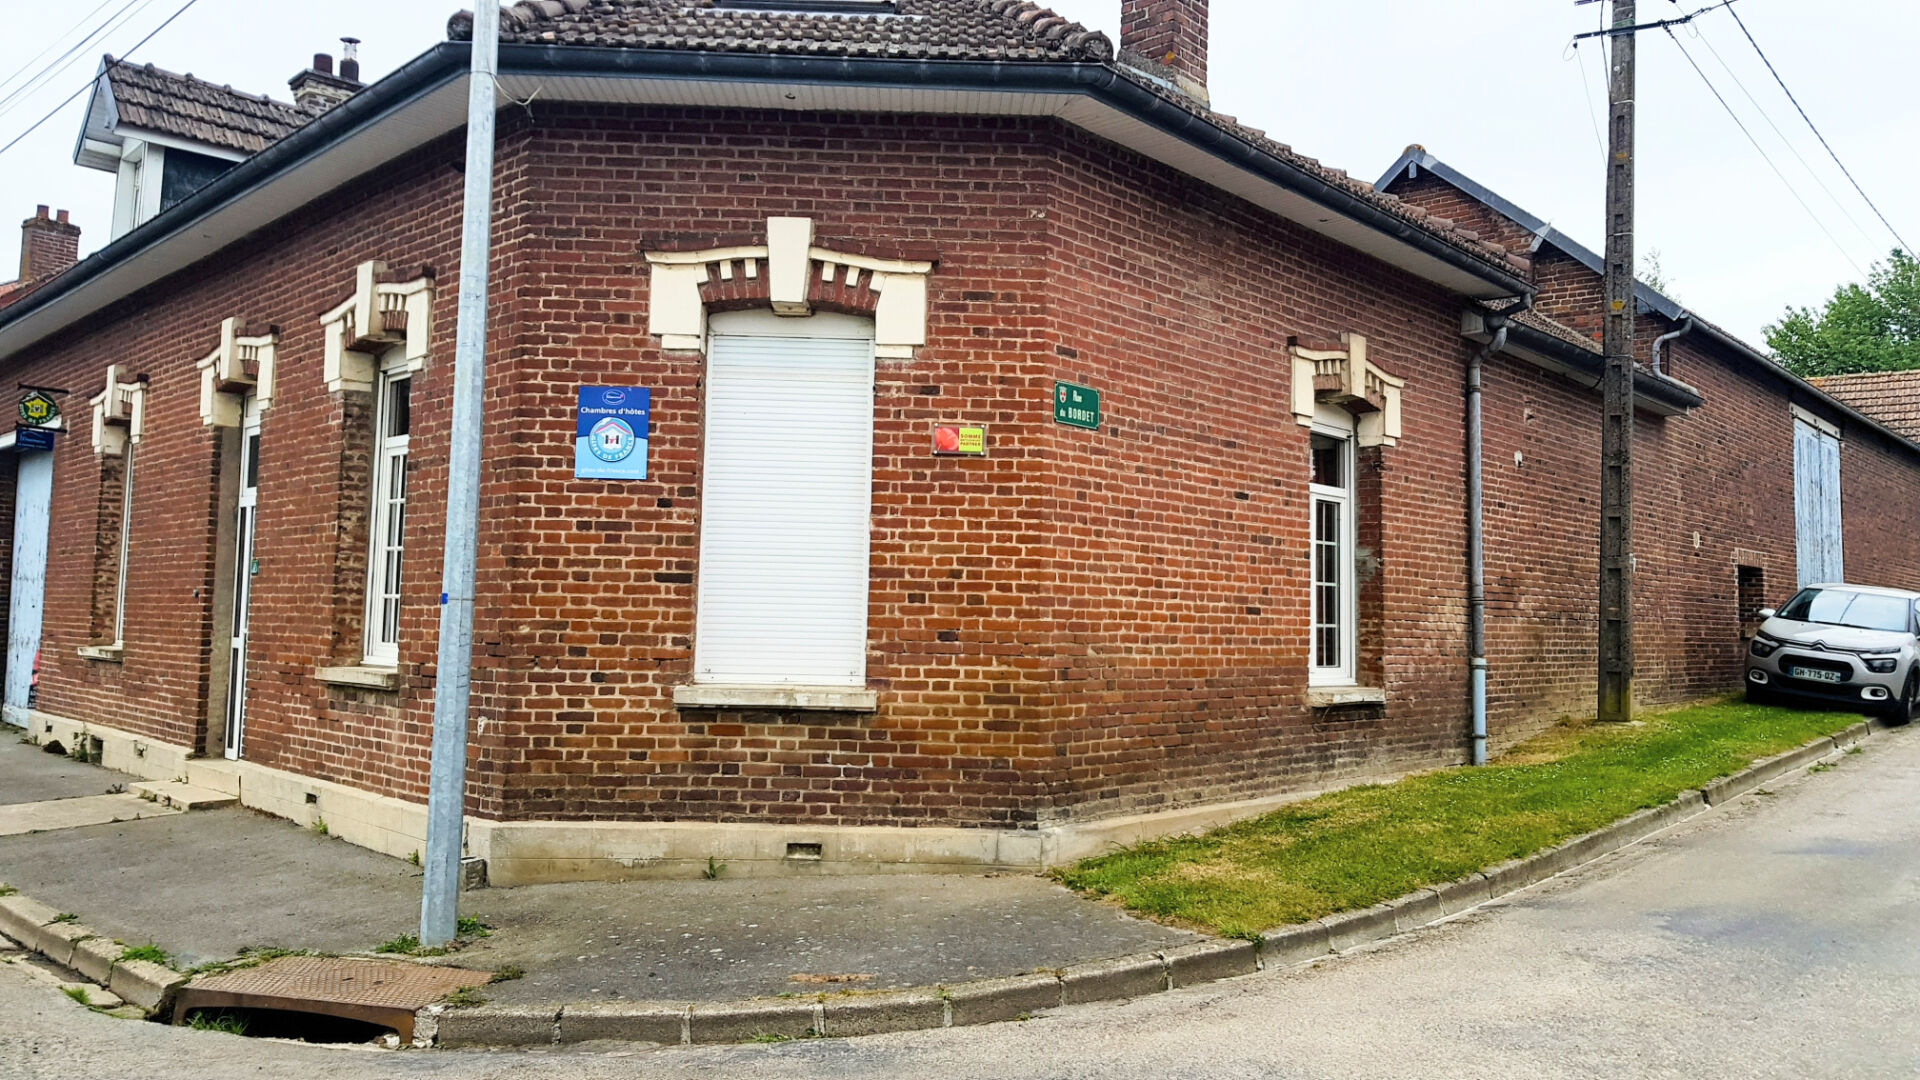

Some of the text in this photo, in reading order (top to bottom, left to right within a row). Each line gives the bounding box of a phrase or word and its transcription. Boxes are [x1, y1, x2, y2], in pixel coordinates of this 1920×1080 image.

[1072, 390, 1083, 403] Rue
[580, 406, 646, 416] Chambres d'hôtes
[1068, 407, 1095, 423] BORDET
